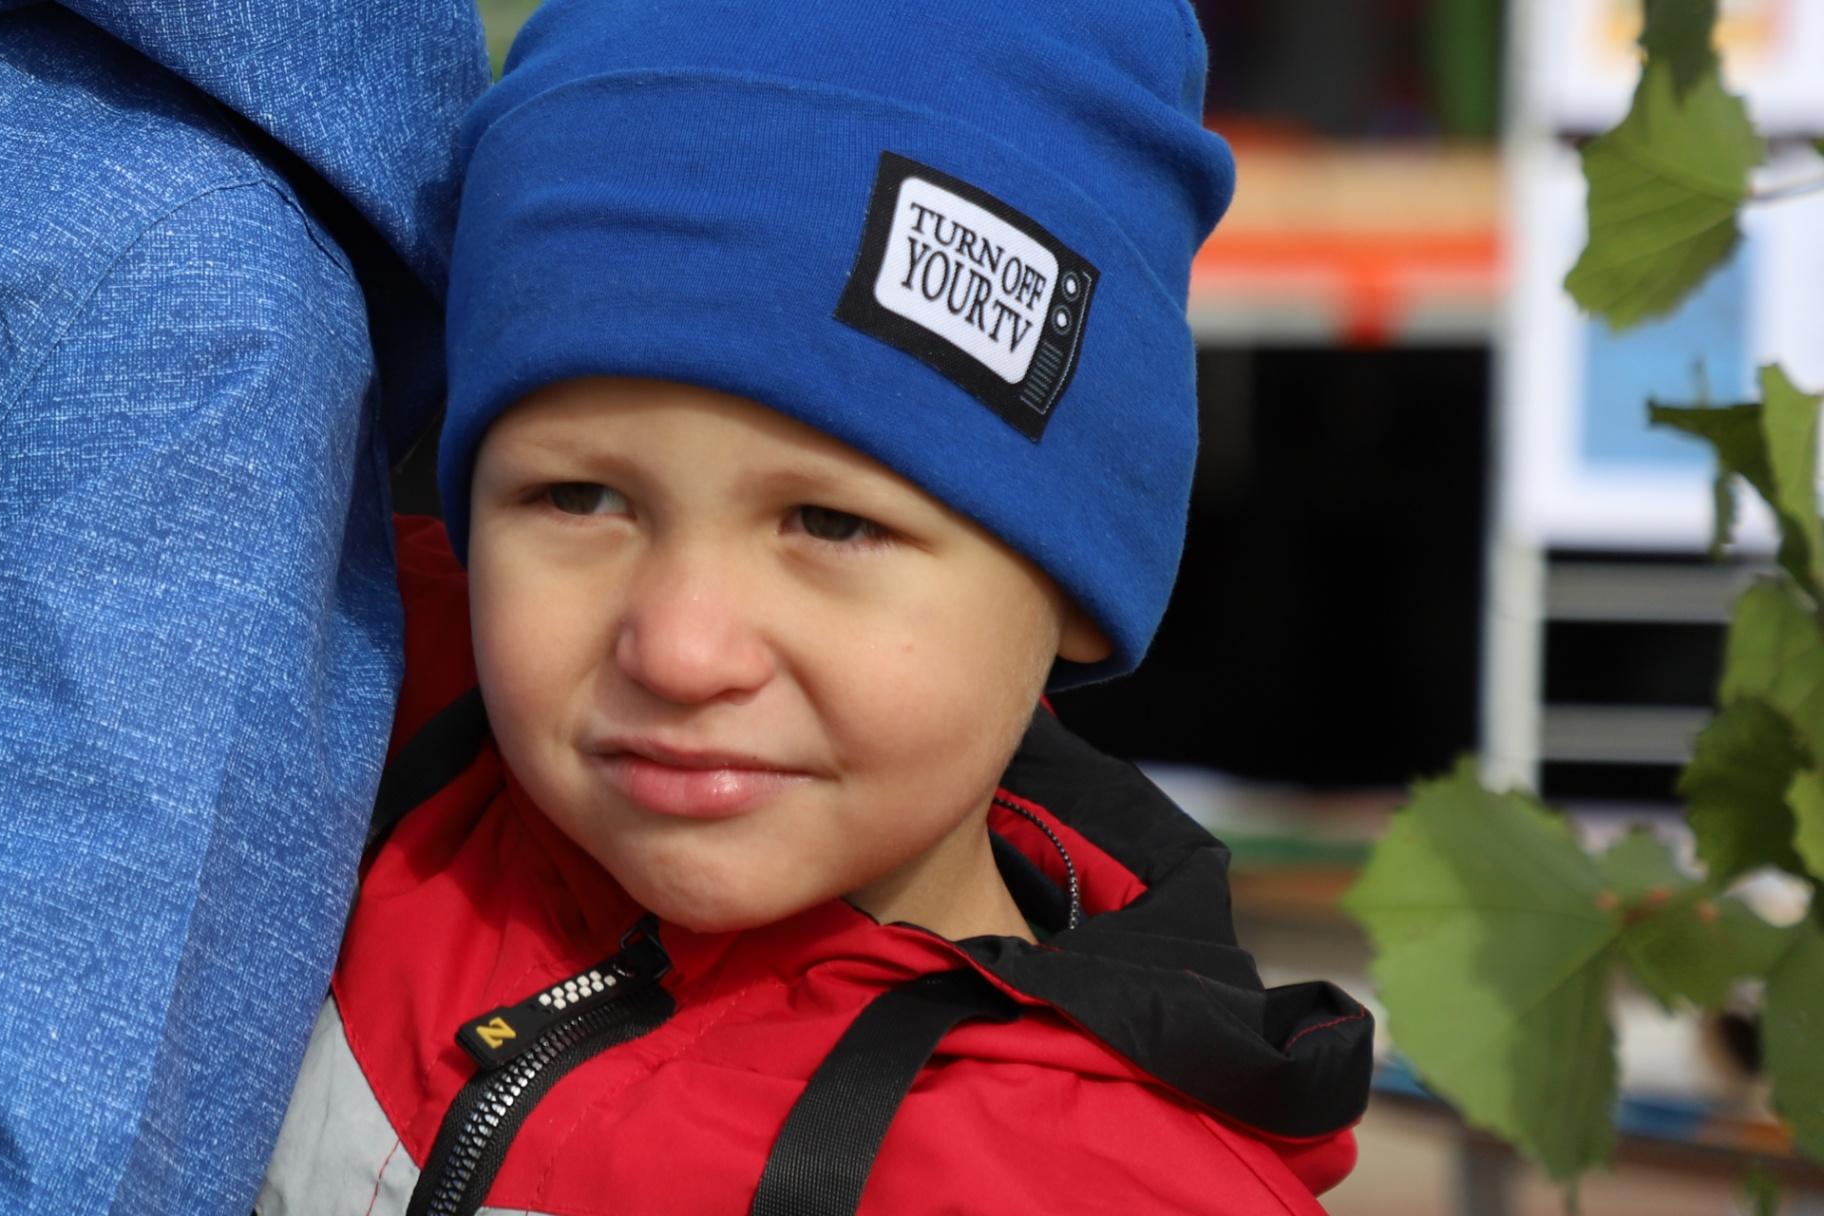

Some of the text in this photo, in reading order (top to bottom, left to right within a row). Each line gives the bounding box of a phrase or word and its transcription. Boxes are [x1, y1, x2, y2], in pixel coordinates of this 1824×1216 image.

[900, 236, 1034, 354] YOUR TV
[910, 201, 1047, 312] TURN OFF
